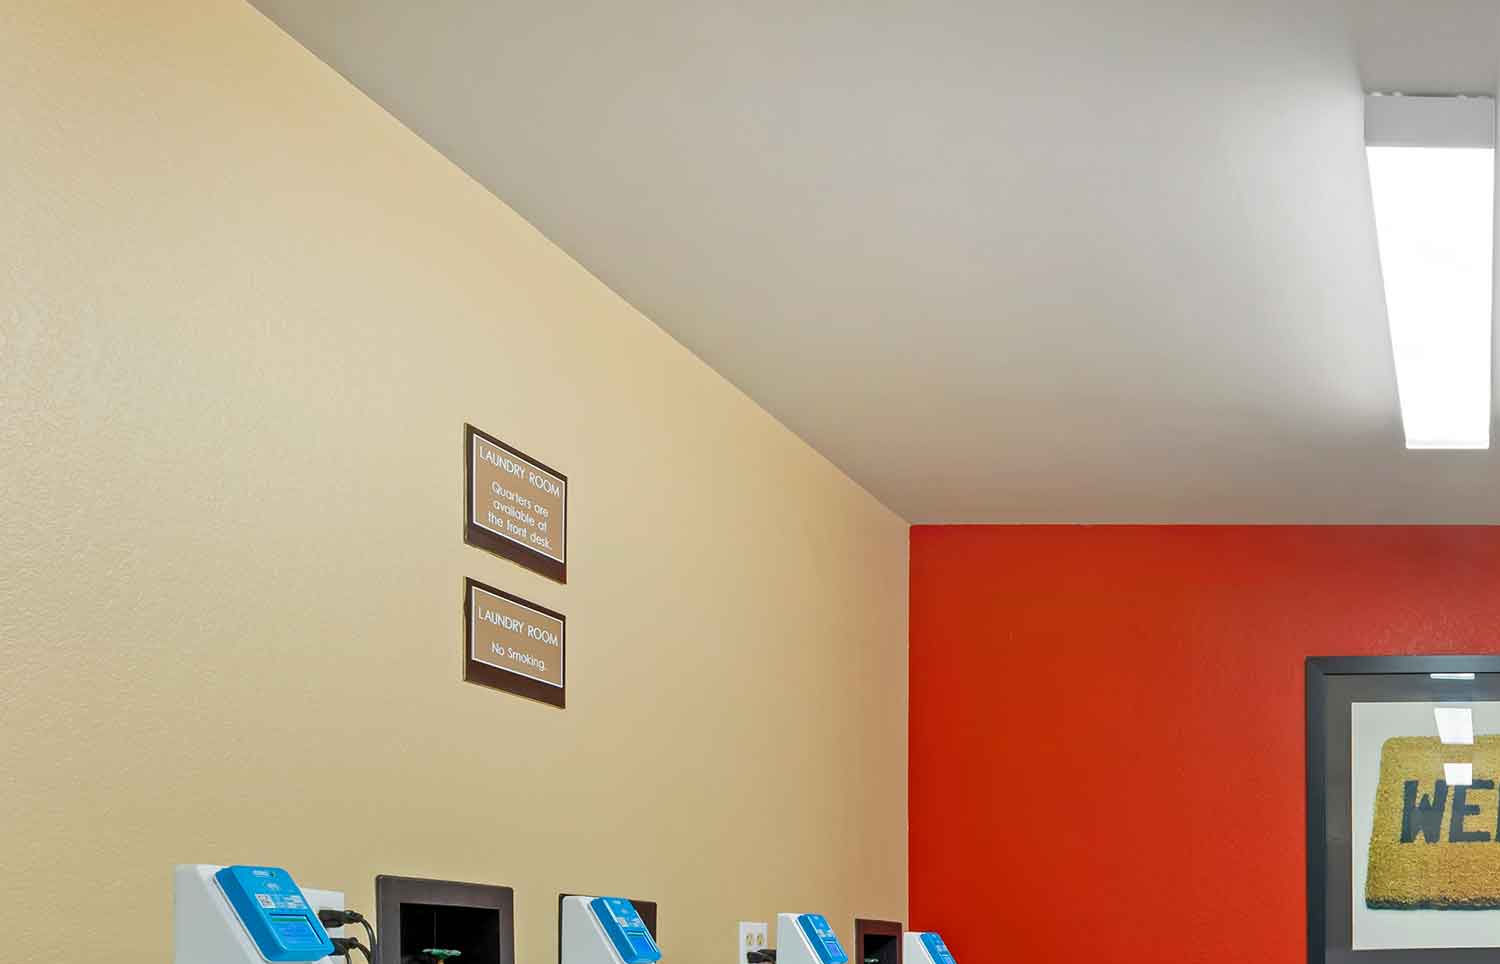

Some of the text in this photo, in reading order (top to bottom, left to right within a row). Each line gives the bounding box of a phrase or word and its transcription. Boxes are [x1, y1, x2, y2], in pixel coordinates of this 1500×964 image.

[479, 446, 560, 497] LAUNDRY ROOM
[491, 480, 549, 518] Quarters are
[492, 500, 547, 532] available at
[487, 511, 504, 527] the
[506, 520, 528, 537] front
[478, 607, 559, 647] LAUNDRY ROOM
[491, 641, 505, 656] No
